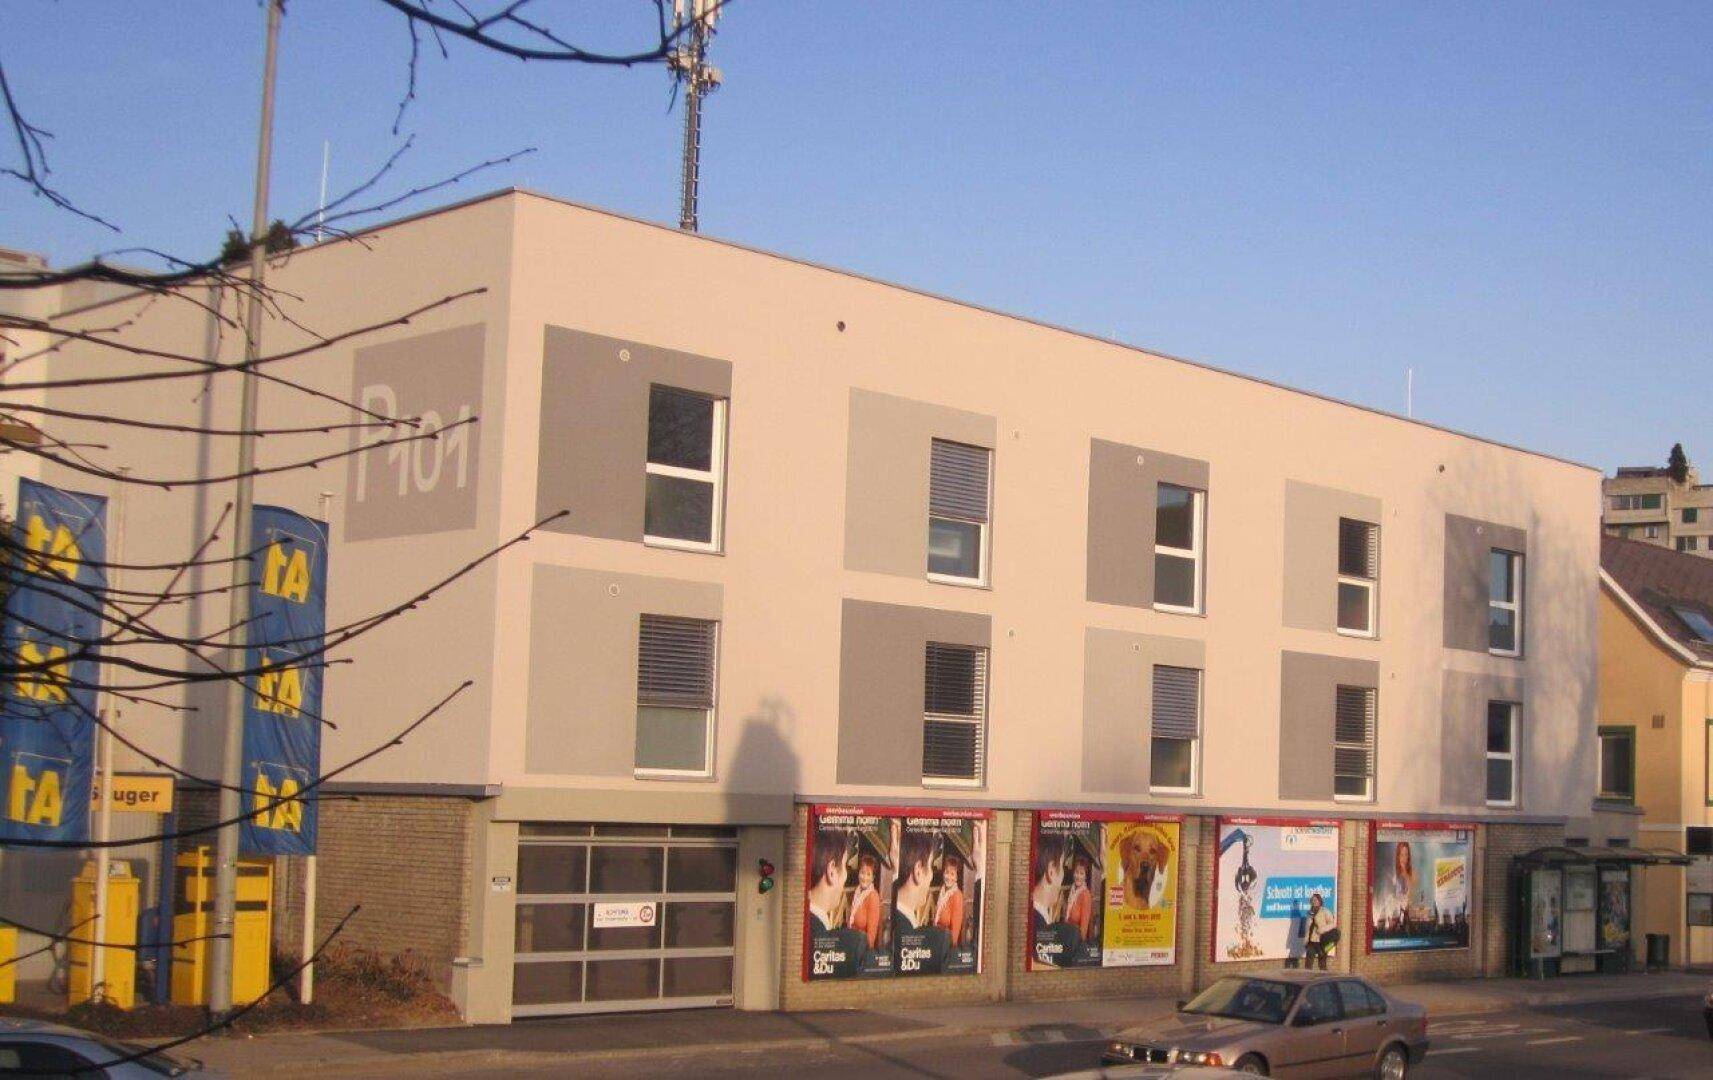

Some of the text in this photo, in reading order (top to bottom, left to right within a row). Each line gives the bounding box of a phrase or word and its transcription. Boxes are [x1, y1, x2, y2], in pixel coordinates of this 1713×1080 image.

[356, 384, 471, 502] P101
[91, 785, 160, 805] Suger
[814, 949, 847, 963] Caritas
[901, 947, 931, 959] Caritas
[813, 962, 834, 975] &Du
[901, 958, 921, 971] &Du
